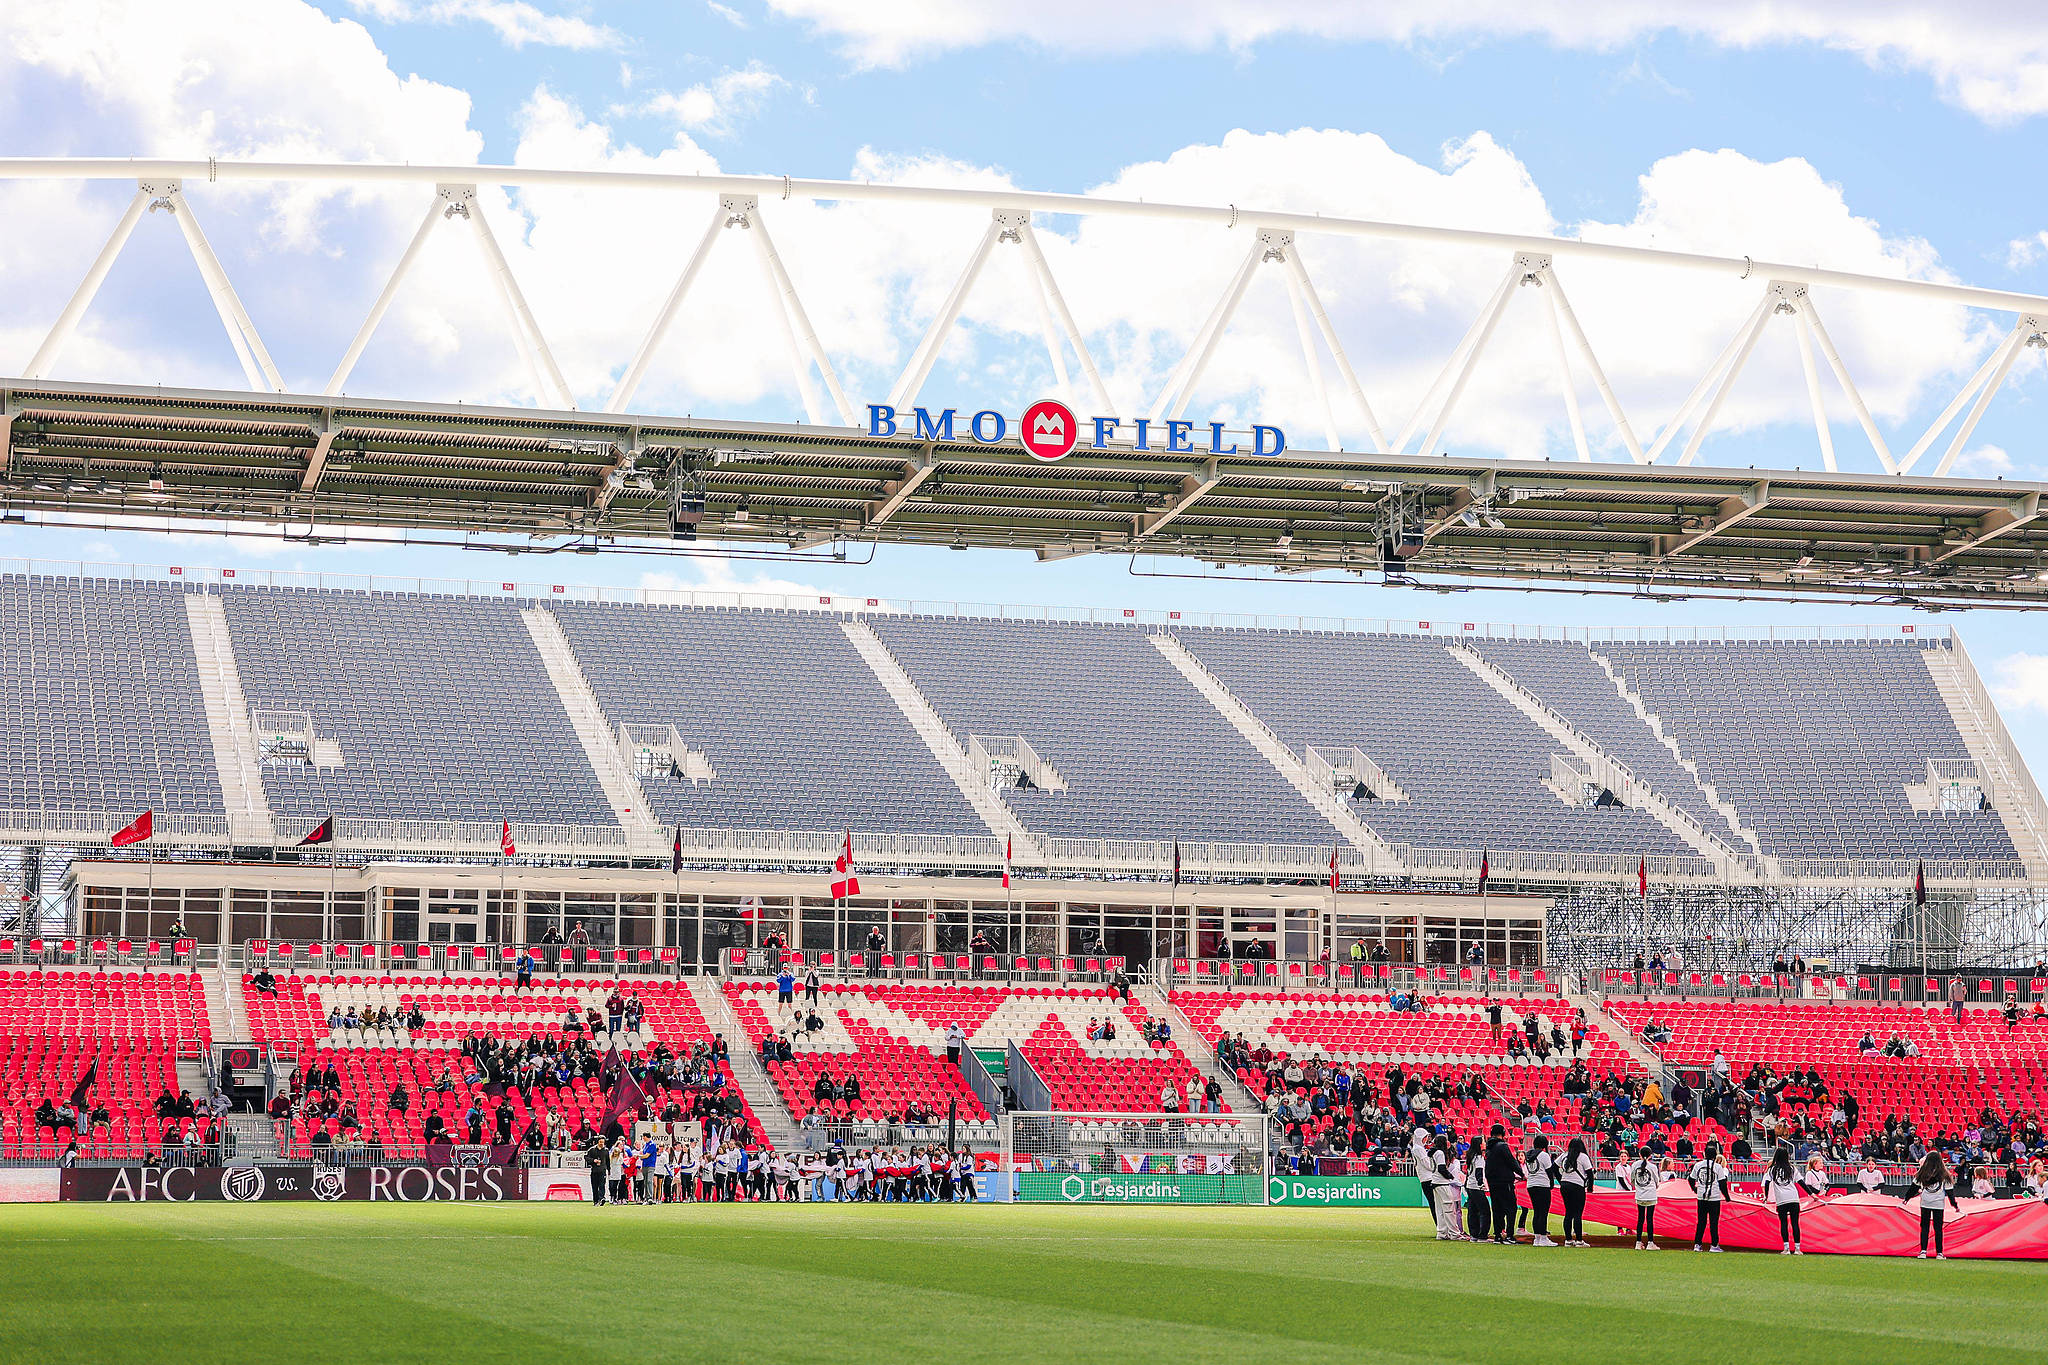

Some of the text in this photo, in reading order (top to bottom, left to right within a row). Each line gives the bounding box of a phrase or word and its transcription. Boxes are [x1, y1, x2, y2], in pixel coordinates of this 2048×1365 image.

[866, 404, 1287, 458] BMO FIELD
[181, 940, 192, 948] 113
[254, 940, 266, 948] 114
[663, 948, 675, 956] 114
[1112, 958, 1122, 966] 115
[1175, 959, 1186, 967] 116
[1608, 969, 1618, 977] 117
[2035, 978, 2046, 986] 117
[1546, 984, 1557, 992] 116
[106, 1167, 195, 1201] AFC
[276, 1177, 299, 1191] vs.
[370, 1166, 503, 1201] ROSES
[1091, 1181, 1181, 1201] Desjardins
[1292, 1182, 1381, 1202] Desjardins
